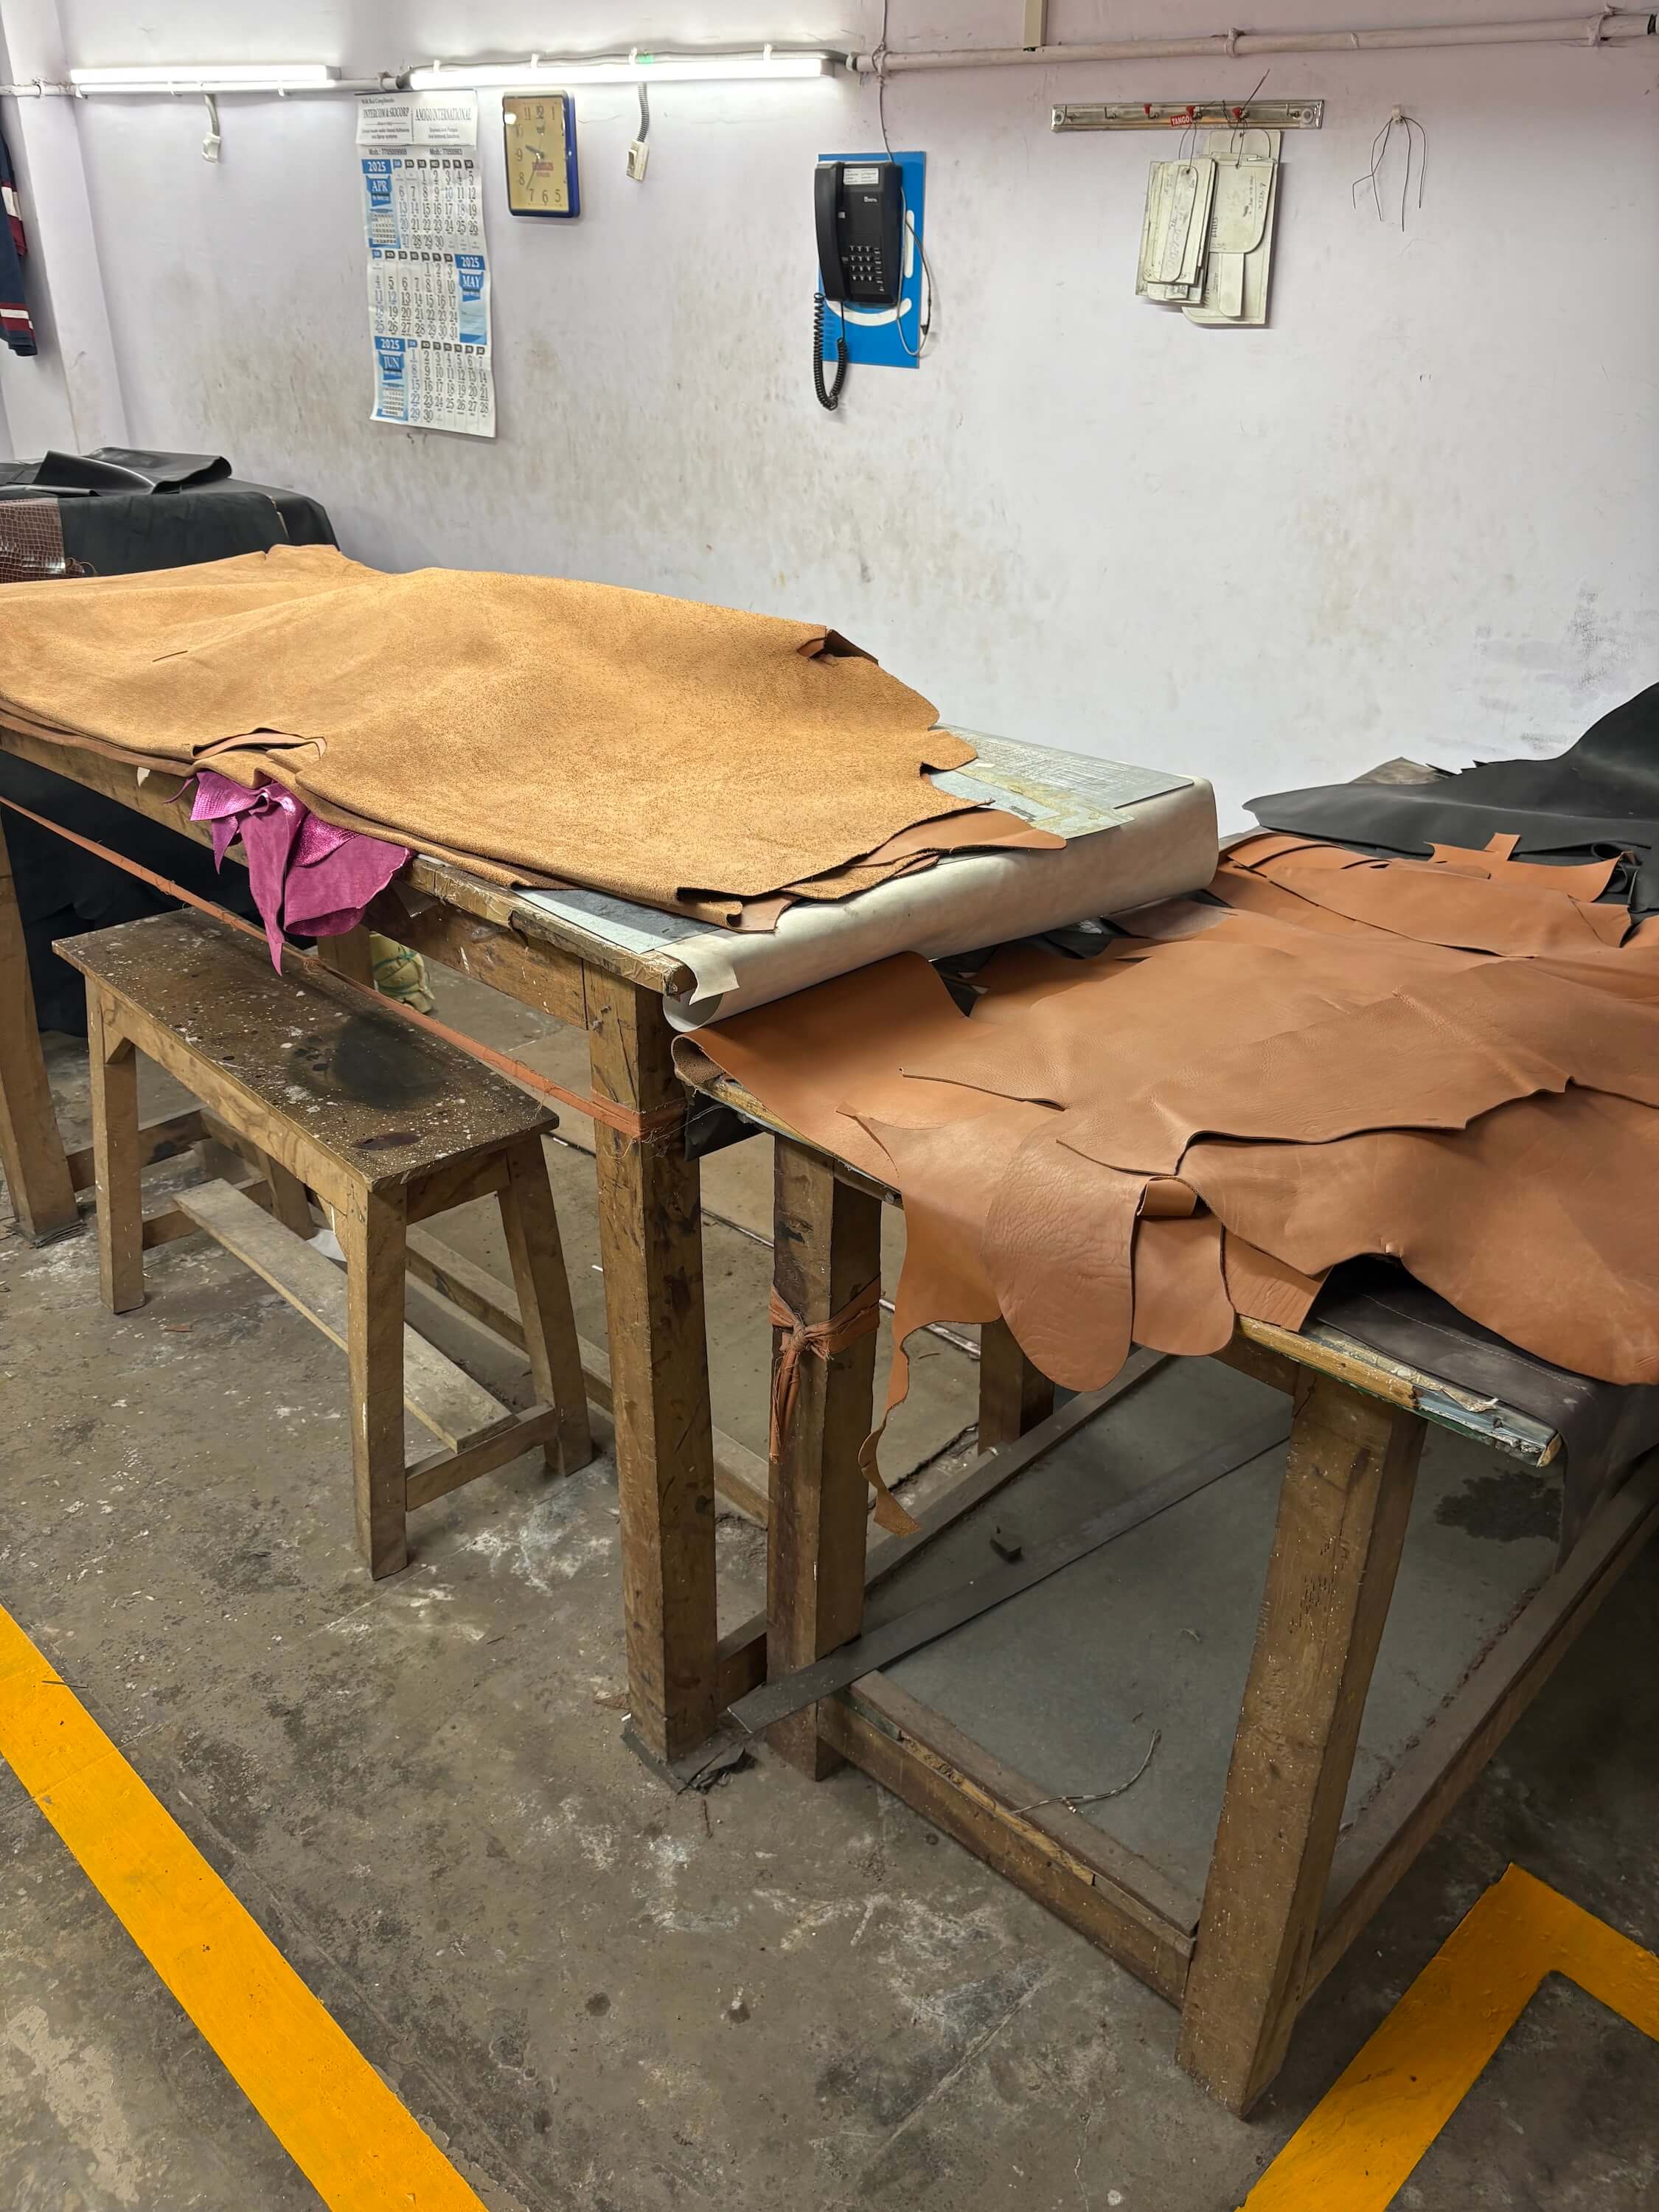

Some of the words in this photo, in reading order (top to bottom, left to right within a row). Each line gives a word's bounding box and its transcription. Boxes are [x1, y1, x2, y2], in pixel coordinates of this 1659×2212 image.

[1172, 116, 1189, 125] TANGO
[368, 161, 386, 171] 2025
[422, 170, 425, 182] 1
[434, 171, 438, 181] 2
[445, 171, 451, 183] 3
[457, 171, 462, 182] 4
[469, 171, 473, 183] 5
[519, 173, 525, 185] 8
[372, 181, 388, 192] APR
[399, 186, 405, 197] 6
[411, 187, 415, 197] 7
[423, 187, 428, 198] 8
[434, 187, 439, 198] 9
[445, 188, 453, 199] 10
[457, 188, 464, 199] 11
[468, 188, 476, 199] 12
[543, 189, 548, 203] 6
[555, 189, 560, 202] 5
[411, 203, 419, 214] 14
[422, 204, 431, 215] 15
[434, 204, 442, 215] 16
[445, 204, 453, 215] 17
[468, 204, 476, 216] 19
[411, 219, 419, 229] 21
[422, 219, 431, 230] 22
[434, 220, 442, 231] 23
[445, 220, 453, 232] 24
[456, 220, 465, 232] 25
[468, 220, 478, 232] 26
[412, 234, 421, 246] 28
[424, 235, 433, 247] 29
[435, 236, 443, 247] 30
[461, 257, 479, 267] 2025
[425, 263, 429, 274] 1
[437, 263, 441, 274] 2
[448, 264, 452, 275] 3
[389, 276, 394, 287] 5
[402, 278, 407, 288] 6
[426, 279, 431, 290] 8
[437, 280, 442, 291] 9
[448, 280, 455, 291] 10
[462, 276, 480, 287] MAY
[375, 291, 382, 301] 11
[389, 291, 397, 302] 12
[402, 293, 410, 303] 13
[414, 293, 422, 304] 14
[426, 295, 434, 305] 15
[437, 295, 445, 305] 16
[449, 296, 456, 307] 17
[389, 307, 397, 317] 19
[402, 308, 411, 318] 20
[415, 309, 423, 319] 21
[426, 310, 434, 320] 22
[438, 310, 446, 321] 23
[449, 312, 458, 321] 24
[375, 320, 384, 330] 25
[388, 321, 397, 331] 26
[401, 322, 411, 333] 27
[415, 324, 425, 334] 28
[428, 324, 436, 335] 29
[439, 326, 447, 336] 30
[450, 327, 458, 338] 31
[381, 339, 400, 348] 2025
[384, 356, 400, 368] JUN
[411, 350, 415, 360] 1
[424, 351, 429, 361] 2
[436, 352, 441, 363] 3
[448, 353, 451, 364] 4
[457, 355, 462, 365] 5
[467, 355, 472, 366] 6
[425, 366, 430, 376] 9
[436, 367, 442, 378] 10
[447, 369, 453, 379] 11
[458, 369, 465, 380] 12
[468, 371, 476, 382] 13
[480, 372, 487, 383] 14
[412, 380, 420, 390] 15
[425, 381, 433, 392] 16
[437, 382, 443, 392] 17
[447, 383, 454, 394] 18
[459, 384, 466, 395] 19
[469, 386, 477, 397] 20
[480, 387, 488, 398] 21
[411, 394, 420, 403] 22
[424, 395, 433, 406] 23
[435, 397, 442, 407] 24
[446, 398, 453, 409] 25
[457, 399, 466, 411] 26
[468, 401, 477, 411] 27
[480, 403, 488, 413] 28
[411, 408, 420, 419] 29
[424, 410, 433, 420] 30
